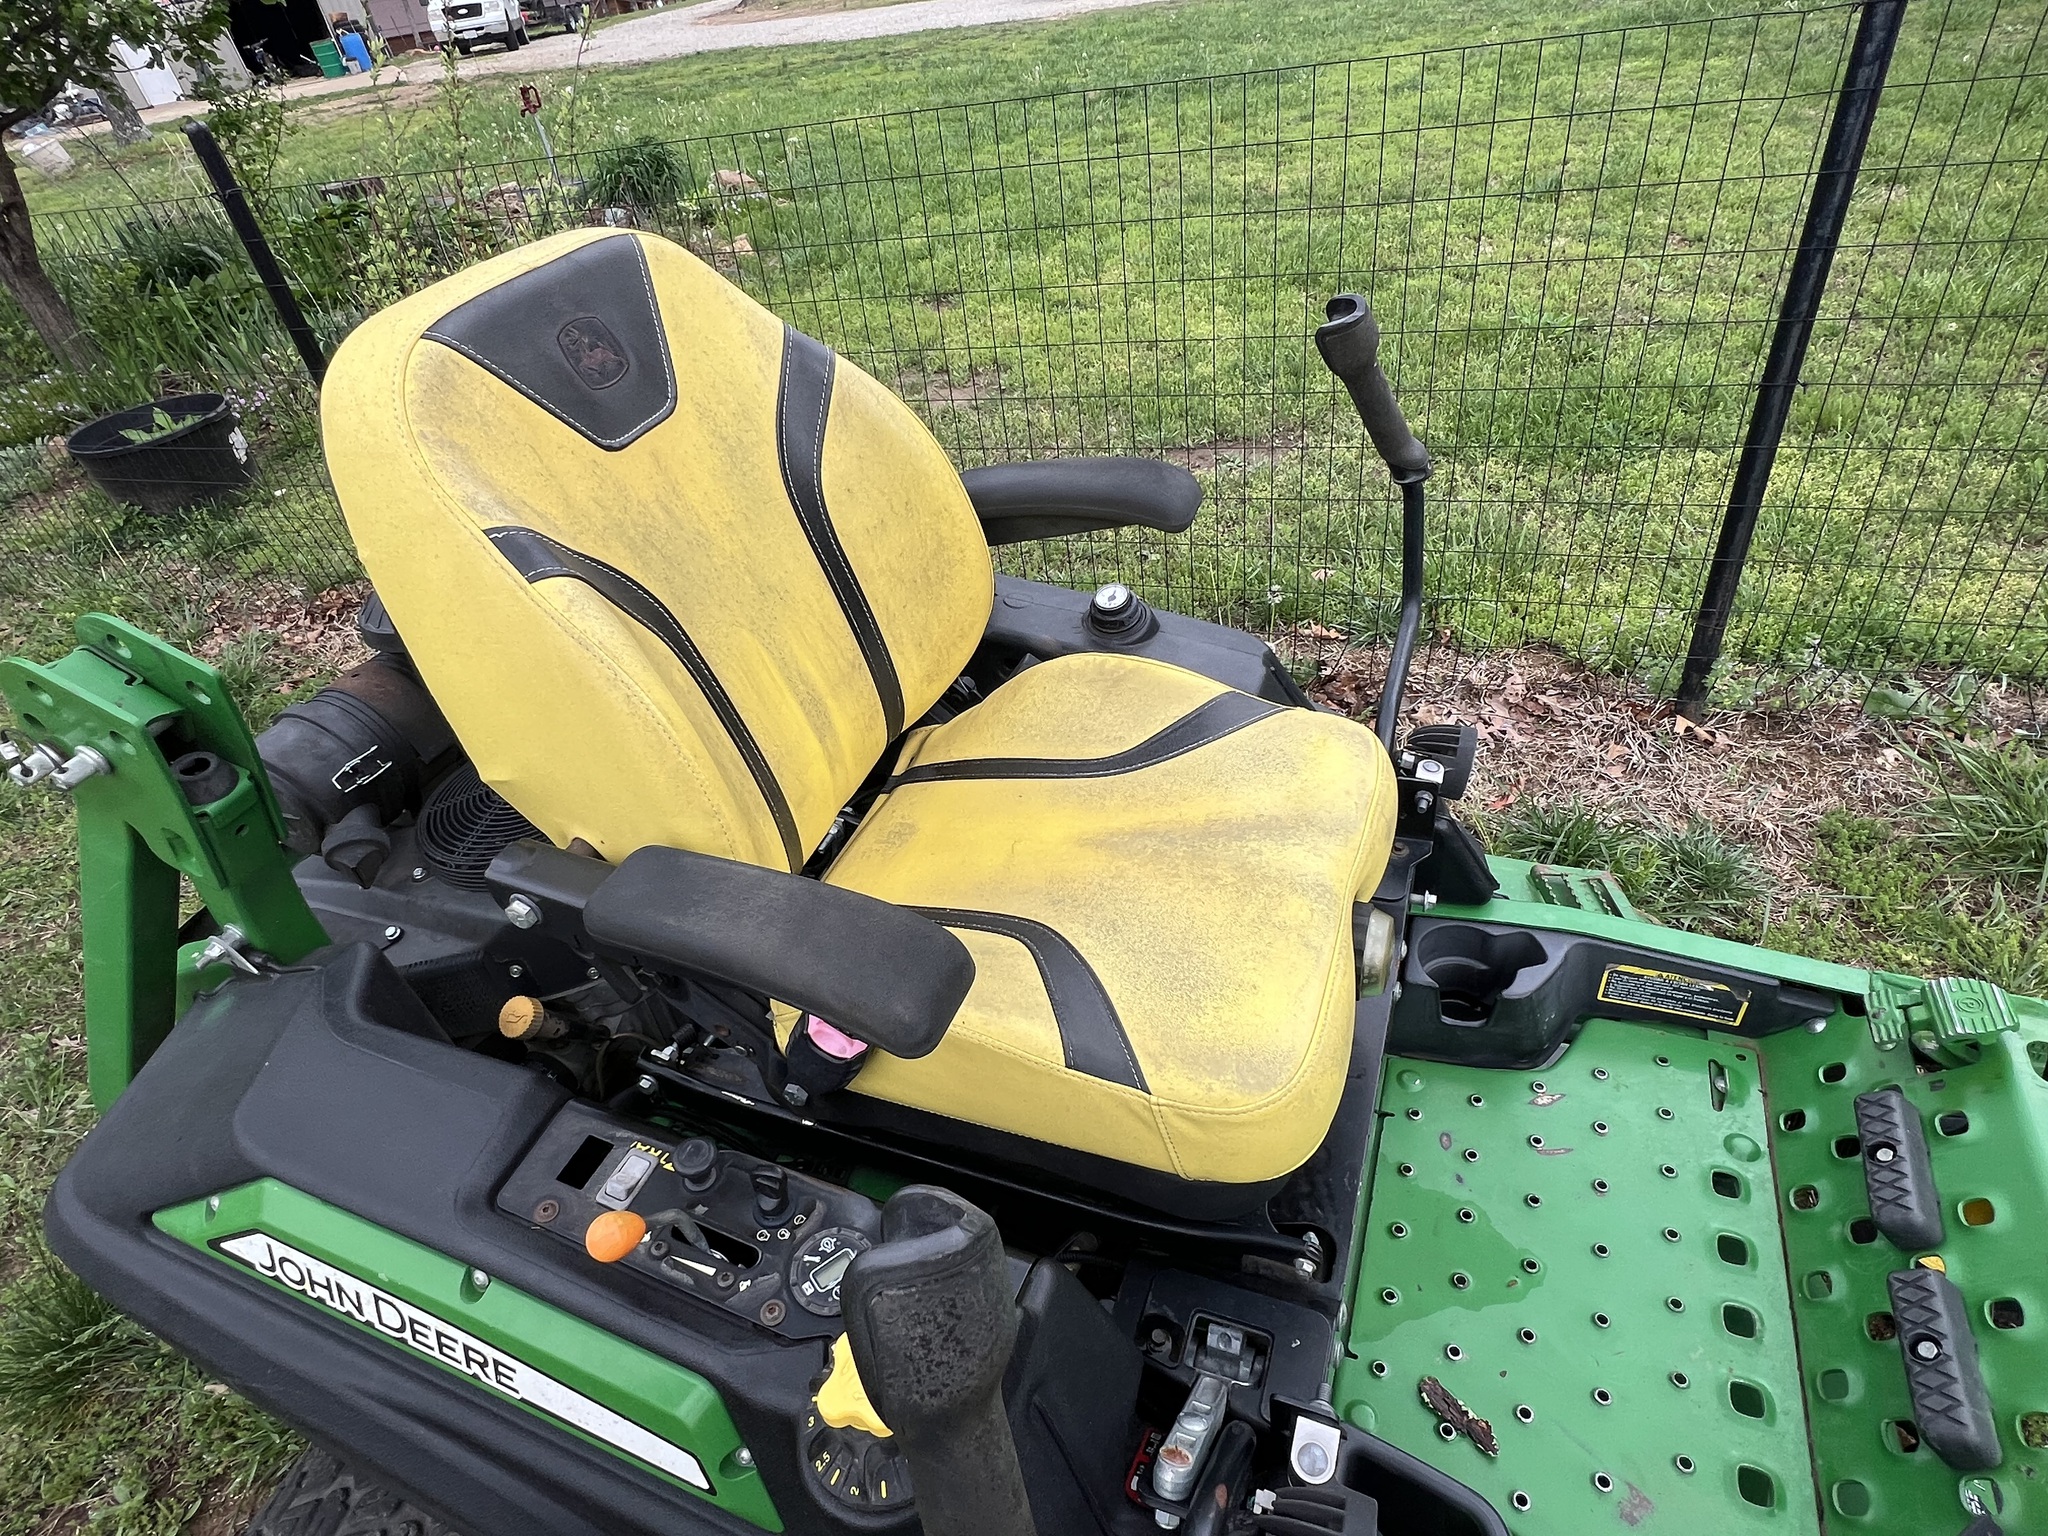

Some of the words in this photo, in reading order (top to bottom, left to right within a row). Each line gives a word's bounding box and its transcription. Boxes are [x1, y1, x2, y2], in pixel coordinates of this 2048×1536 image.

[262, 1241, 365, 1318] JOHN
[373, 1293, 520, 1393] DEERE
[807, 1416, 815, 1427] 3
[815, 1451, 831, 1472] 2.5
[850, 1486, 860, 1496] 2
